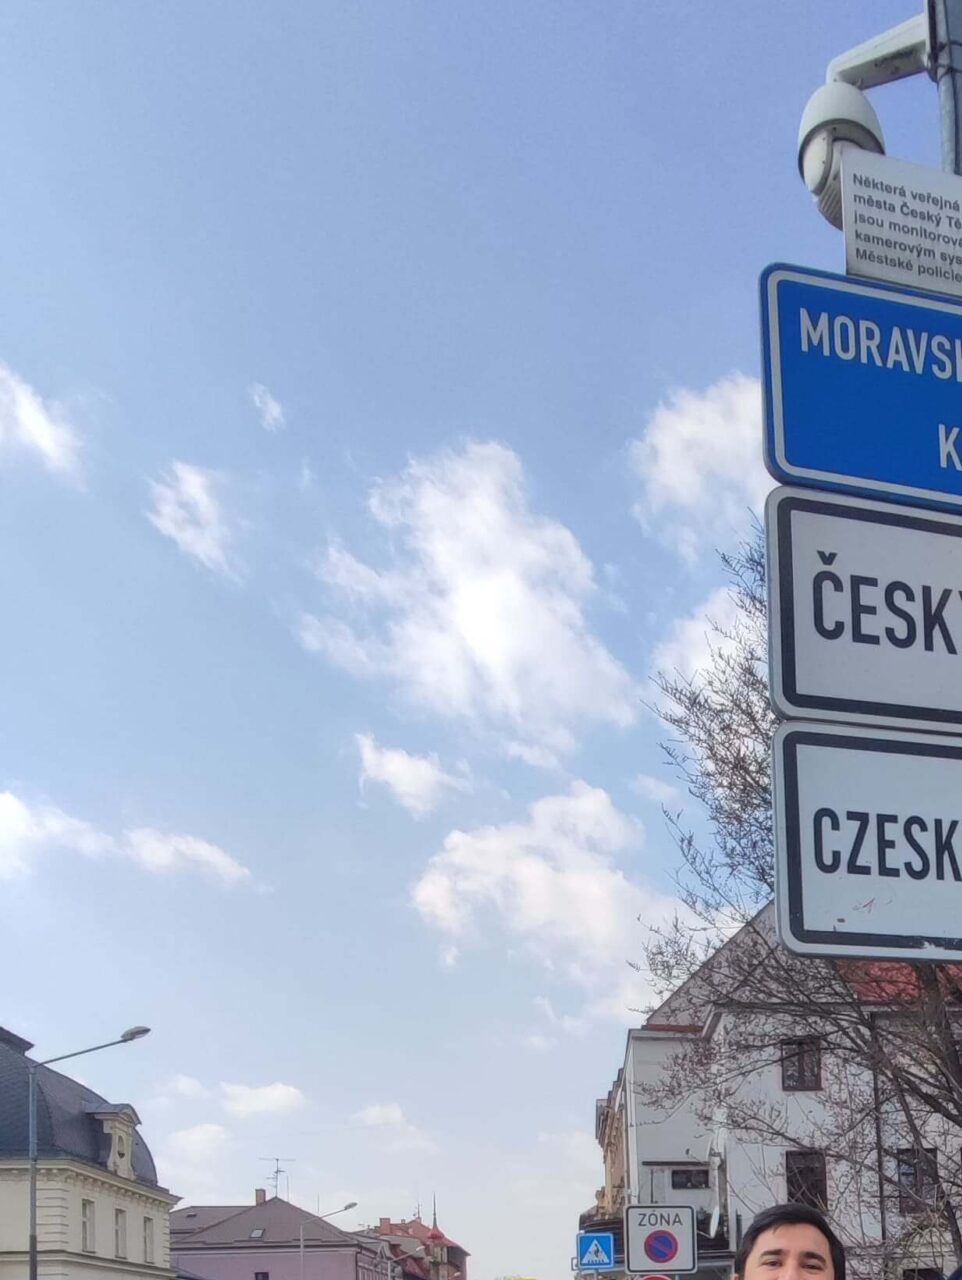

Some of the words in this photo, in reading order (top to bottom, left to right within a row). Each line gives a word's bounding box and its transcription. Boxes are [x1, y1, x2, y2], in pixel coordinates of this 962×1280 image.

[852, 172, 907, 198] Některá
[910, 189, 960, 213] veřejná
[853, 193, 896, 214] města
[899, 201, 942, 227] Český
[853, 210, 885, 229] jsou
[854, 229, 936, 260] kamerovým
[854, 247, 914, 272] Městské
[637, 1210, 684, 1227] ZÓNA
